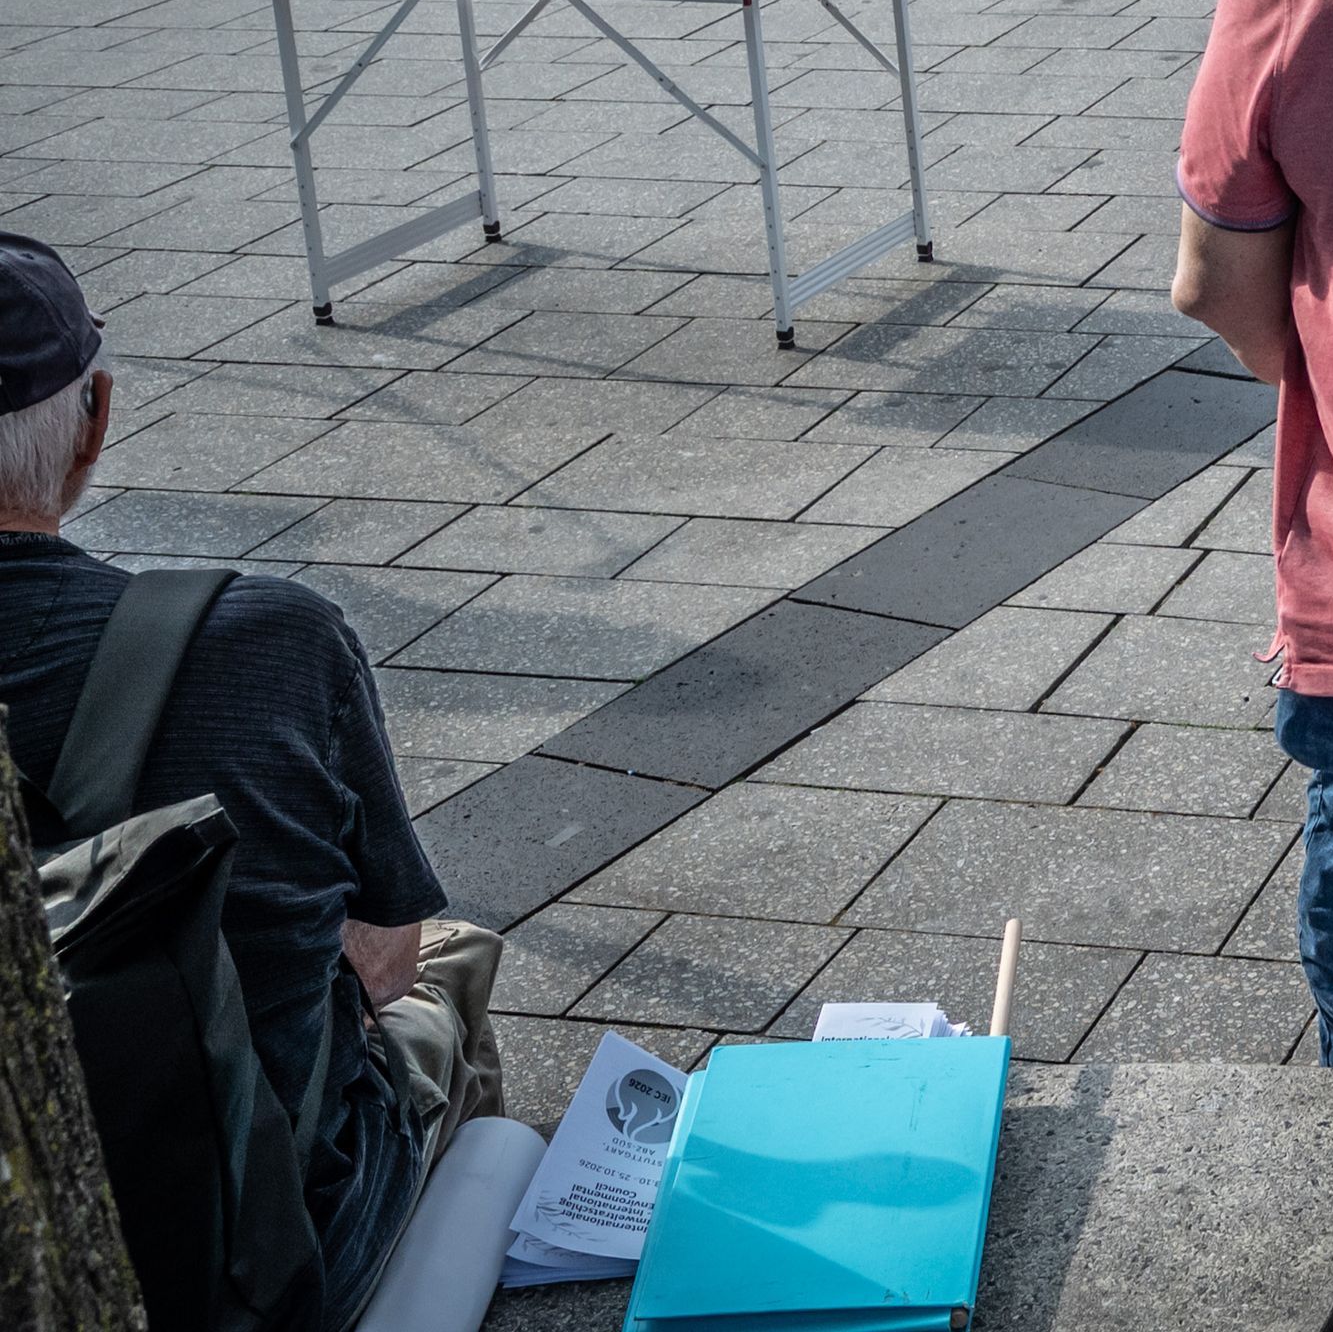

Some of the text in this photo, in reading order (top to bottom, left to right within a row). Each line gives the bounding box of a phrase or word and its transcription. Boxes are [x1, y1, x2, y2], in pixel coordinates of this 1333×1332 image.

[628, 1078, 671, 1105] IEC 2026
[602, 1142, 663, 1168] STUTTGART,
[612, 1136, 656, 1156] ABZ-SÜD
[578, 1158, 632, 1182] 25.10.2026
[571, 1183, 655, 1211] Environmental
[595, 1182, 637, 1199] Council
[568, 1192, 645, 1217] International
[560, 1208, 649, 1234] Internationaler
